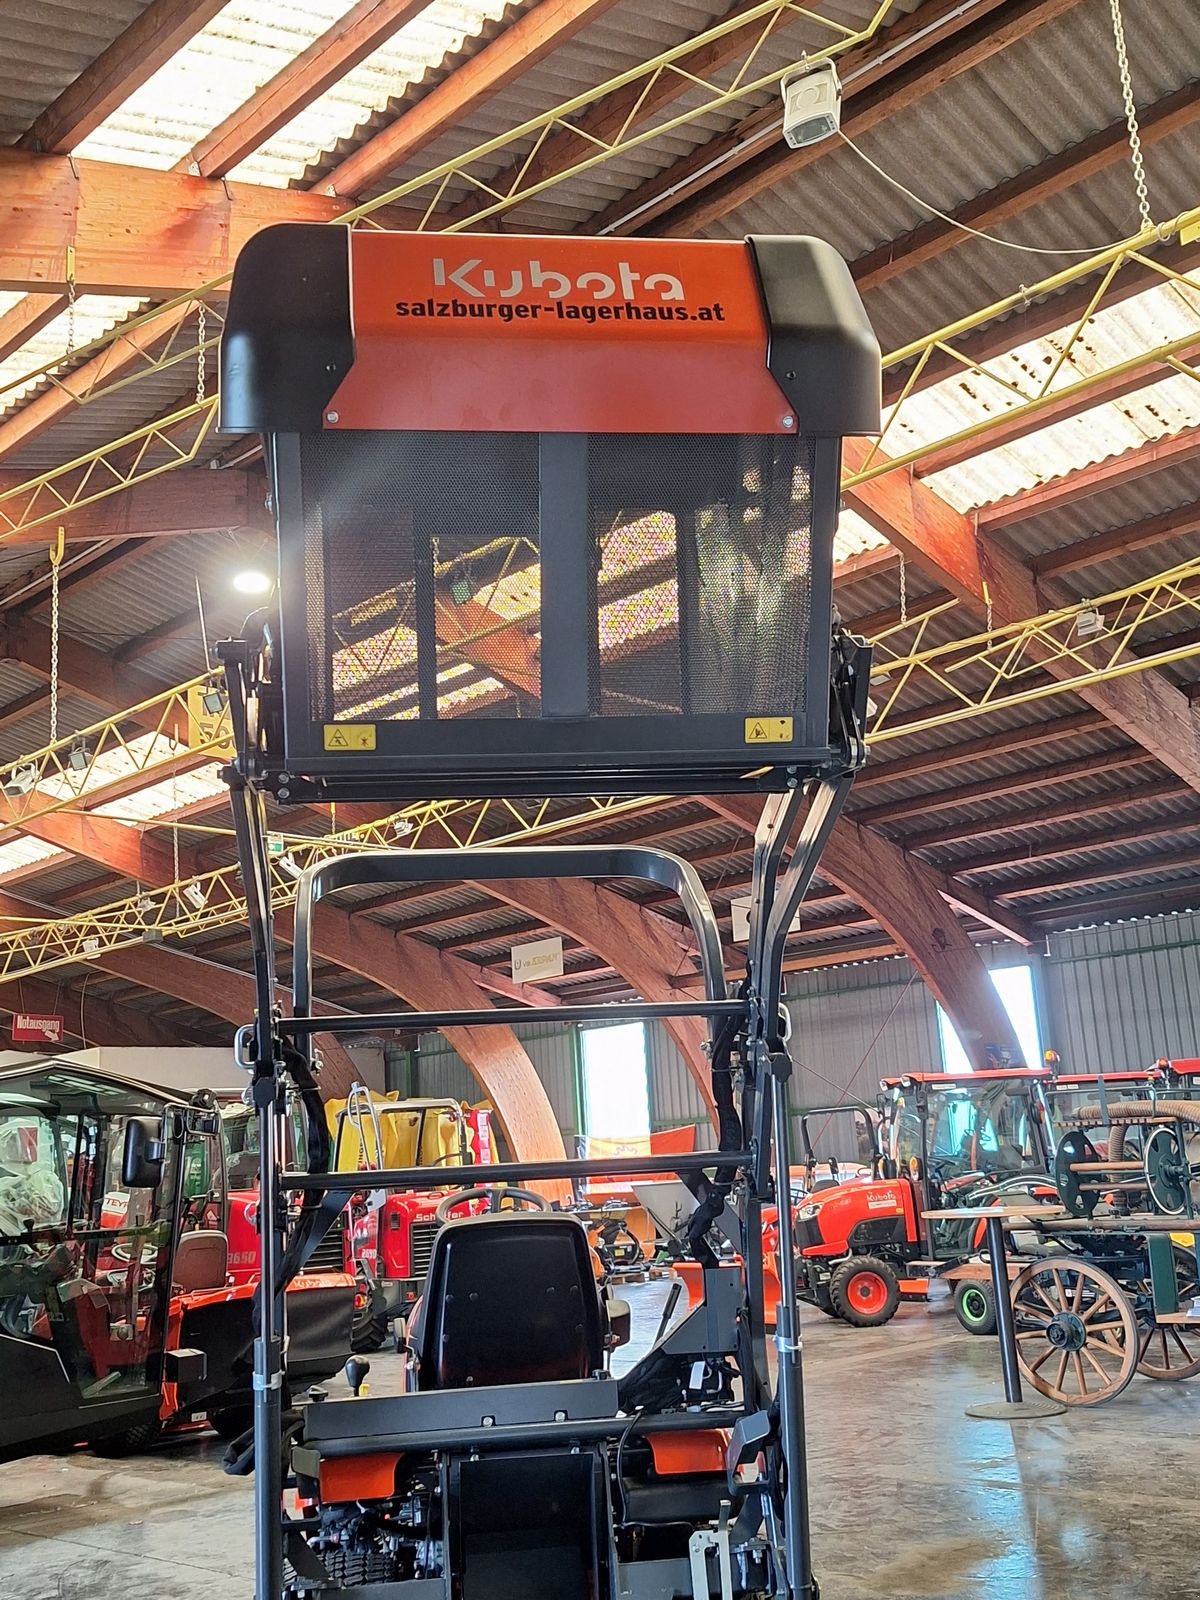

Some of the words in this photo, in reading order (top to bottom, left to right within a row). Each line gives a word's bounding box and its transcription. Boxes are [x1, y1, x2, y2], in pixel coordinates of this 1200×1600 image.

[433, 258, 685, 301] Kubota
[395, 298, 726, 324] salzburger-lagerhaus.at
[16, 1015, 60, 1033] Notausgang
[413, 1210, 464, 1222] Schfer
